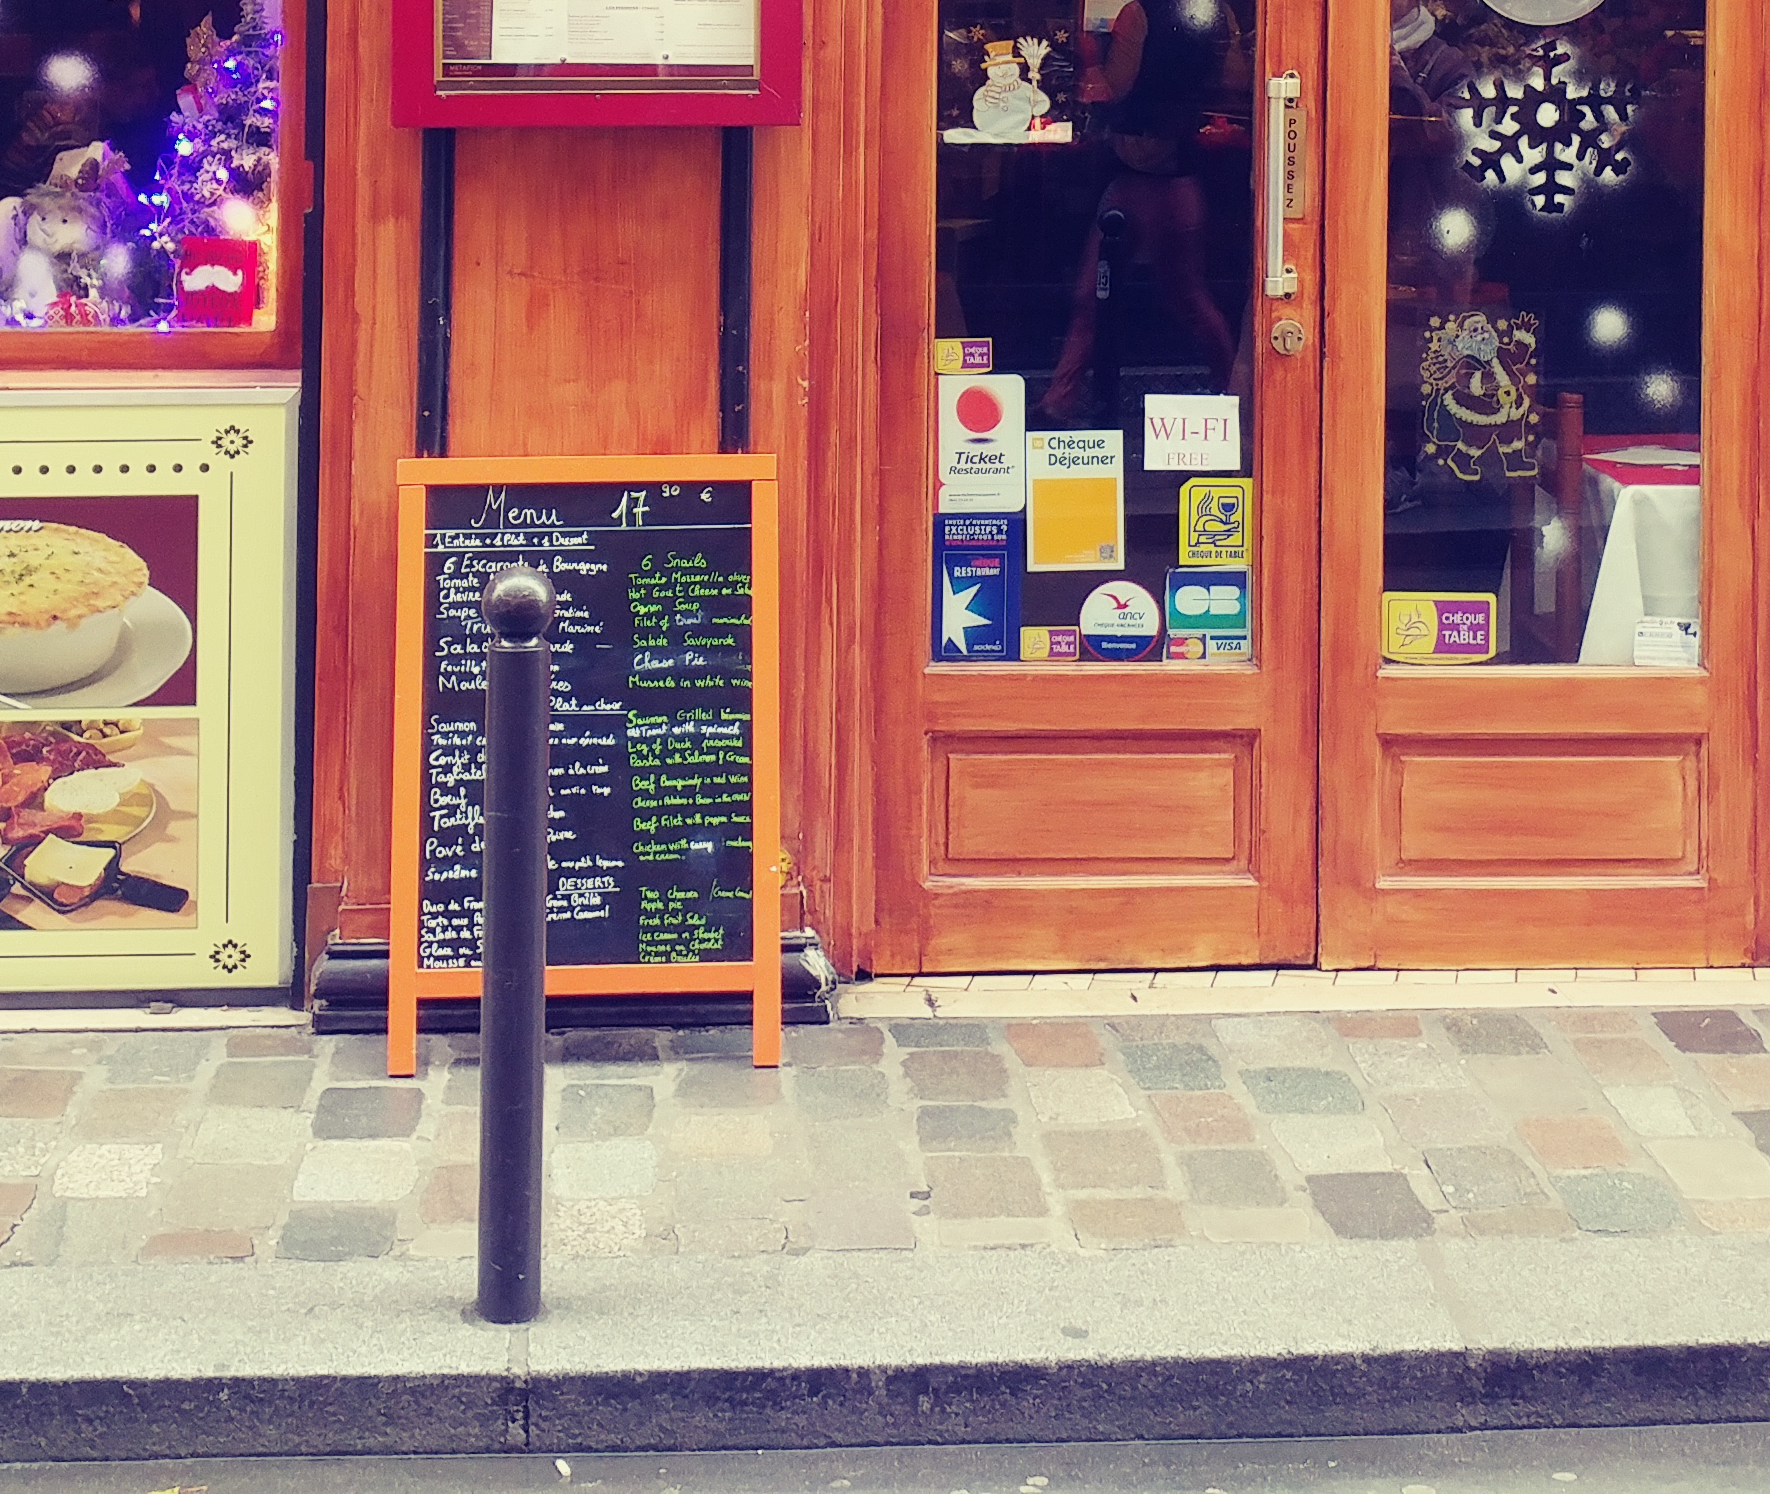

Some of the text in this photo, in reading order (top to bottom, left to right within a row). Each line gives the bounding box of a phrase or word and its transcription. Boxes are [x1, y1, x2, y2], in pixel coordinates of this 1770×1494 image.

[1286, 119, 1297, 208] POUSSEZ
[1147, 417, 1230, 441] WI-FI
[1048, 436, 1105, 452] Chèque
[955, 452, 1005, 464] Ticket
[1048, 452, 1115, 469] Déjeuner
[1167, 453, 1209, 466] FREE
[471, 485, 564, 529] Menu
[945, 526, 998, 534] EXCLUSIFS
[641, 552, 707, 570] 6 Snails
[1215, 550, 1222, 558] DE
[1226, 550, 1244, 558] TABLE
[444, 556, 457, 573] 6
[436, 573, 480, 588] Tomate
[628, 587, 646, 600] Hot
[1175, 586, 1241, 615] CB
[436, 605, 478, 620] Soupe
[673, 598, 700, 614] Soup
[634, 615, 657, 627] Filet
[1118, 612, 1145, 620] ancv
[1442, 611, 1485, 626] CHÈQUE
[1442, 631, 1485, 644] TABLE
[1216, 642, 1241, 651] VISA
[685, 651, 707, 666] Pie
[680, 678, 691, 688] in
[695, 675, 724, 688] white
[677, 708, 713, 721] Grilled
[427, 715, 476, 733] Saumon
[628, 740, 648, 755] Leg
[668, 737, 692, 750] Duck
[429, 749, 471, 771] Confit
[629, 752, 661, 767] Pasta
[430, 787, 468, 811] Boeuf
[633, 816, 659, 834] Beef
[425, 837, 465, 859] Pavé
[558, 876, 615, 891] DESSERTS
[639, 887, 659, 898] Two
[422, 900, 445, 912] Duo
[668, 901, 683, 912] pie
